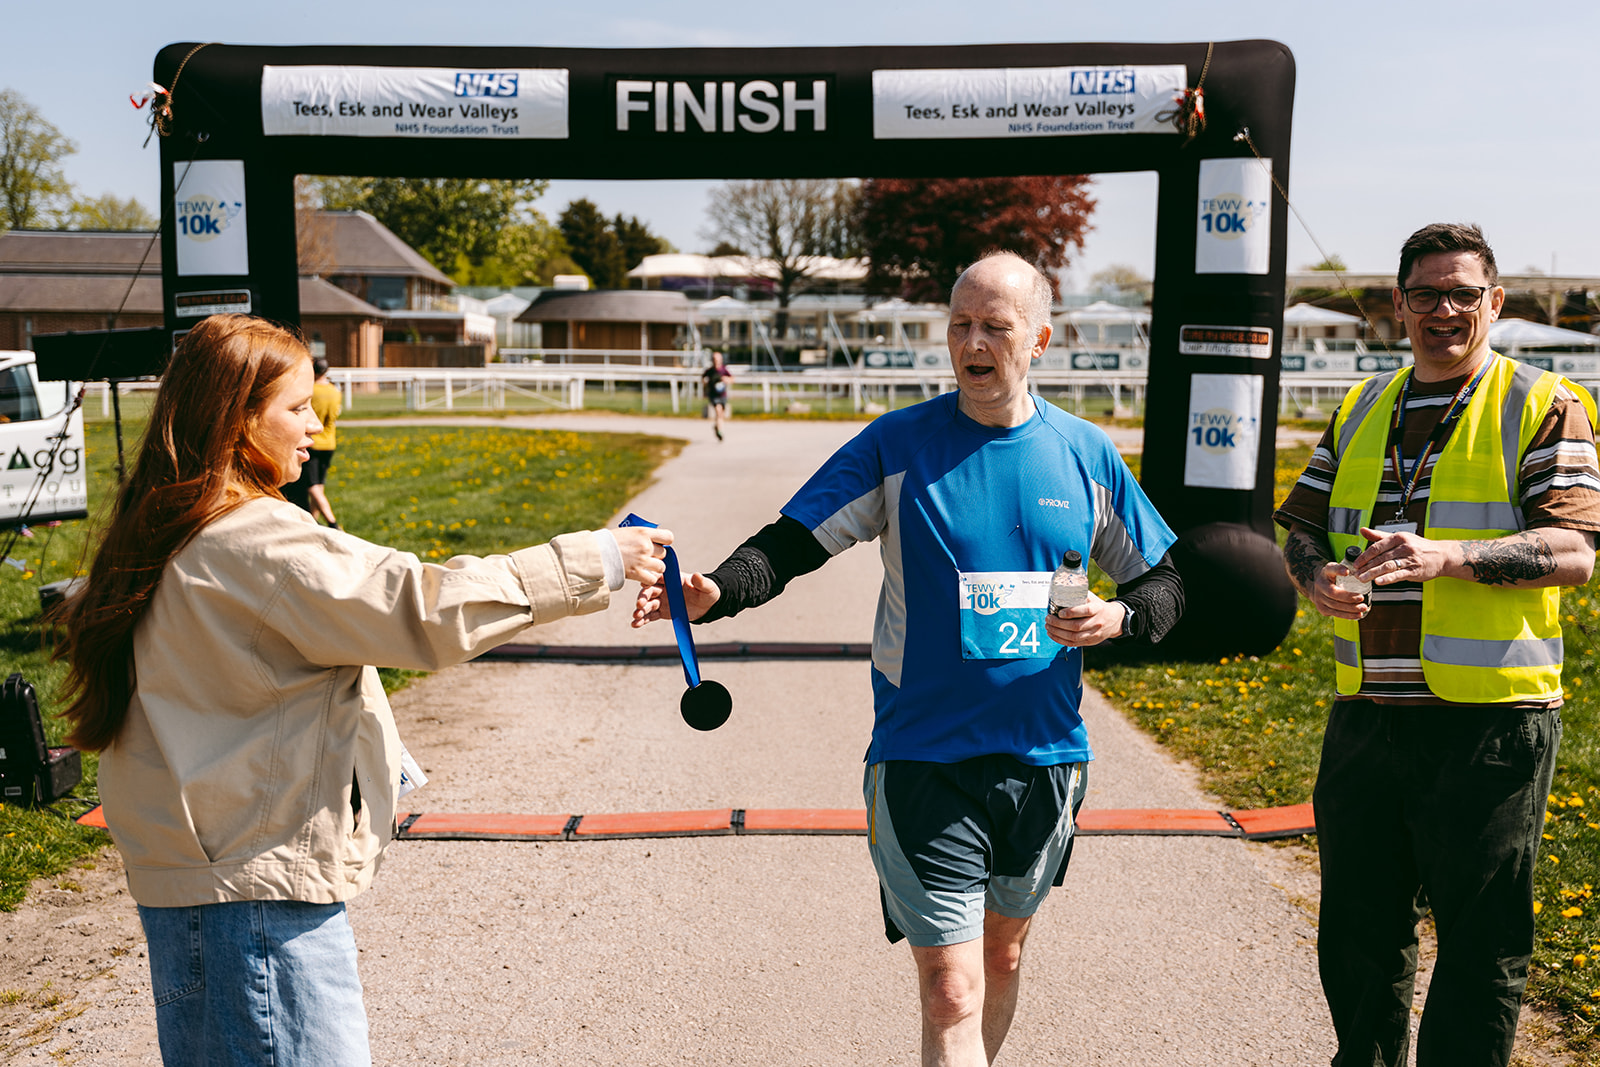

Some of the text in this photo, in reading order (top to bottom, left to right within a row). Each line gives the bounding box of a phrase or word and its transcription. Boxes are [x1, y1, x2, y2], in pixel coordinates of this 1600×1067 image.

[455, 73, 517, 96] NHS
[1070, 71, 1135, 94] NHS
[293, 101, 518, 122] Tees, Esk and Wear Valleys
[616, 79, 827, 133] FINISH
[904, 102, 1135, 120] Tees, Esk and Wear Valleys
[395, 123, 519, 135] NHS Foundation Trust
[1008, 119, 1134, 133] NHS Foundation Trust
[177, 202, 215, 214] TEWV
[1201, 199, 1242, 212] TEWV
[178, 214, 221, 235] 10k
[1201, 212, 1246, 233] 10k
[1456, 385, 1470, 402] NHS
[1192, 412, 1233, 425] TEWV
[1191, 426, 1236, 448] 10k
[966, 583, 996, 593] TEWV
[966, 593, 1001, 609] 10k
[999, 621, 1041, 654] 24
